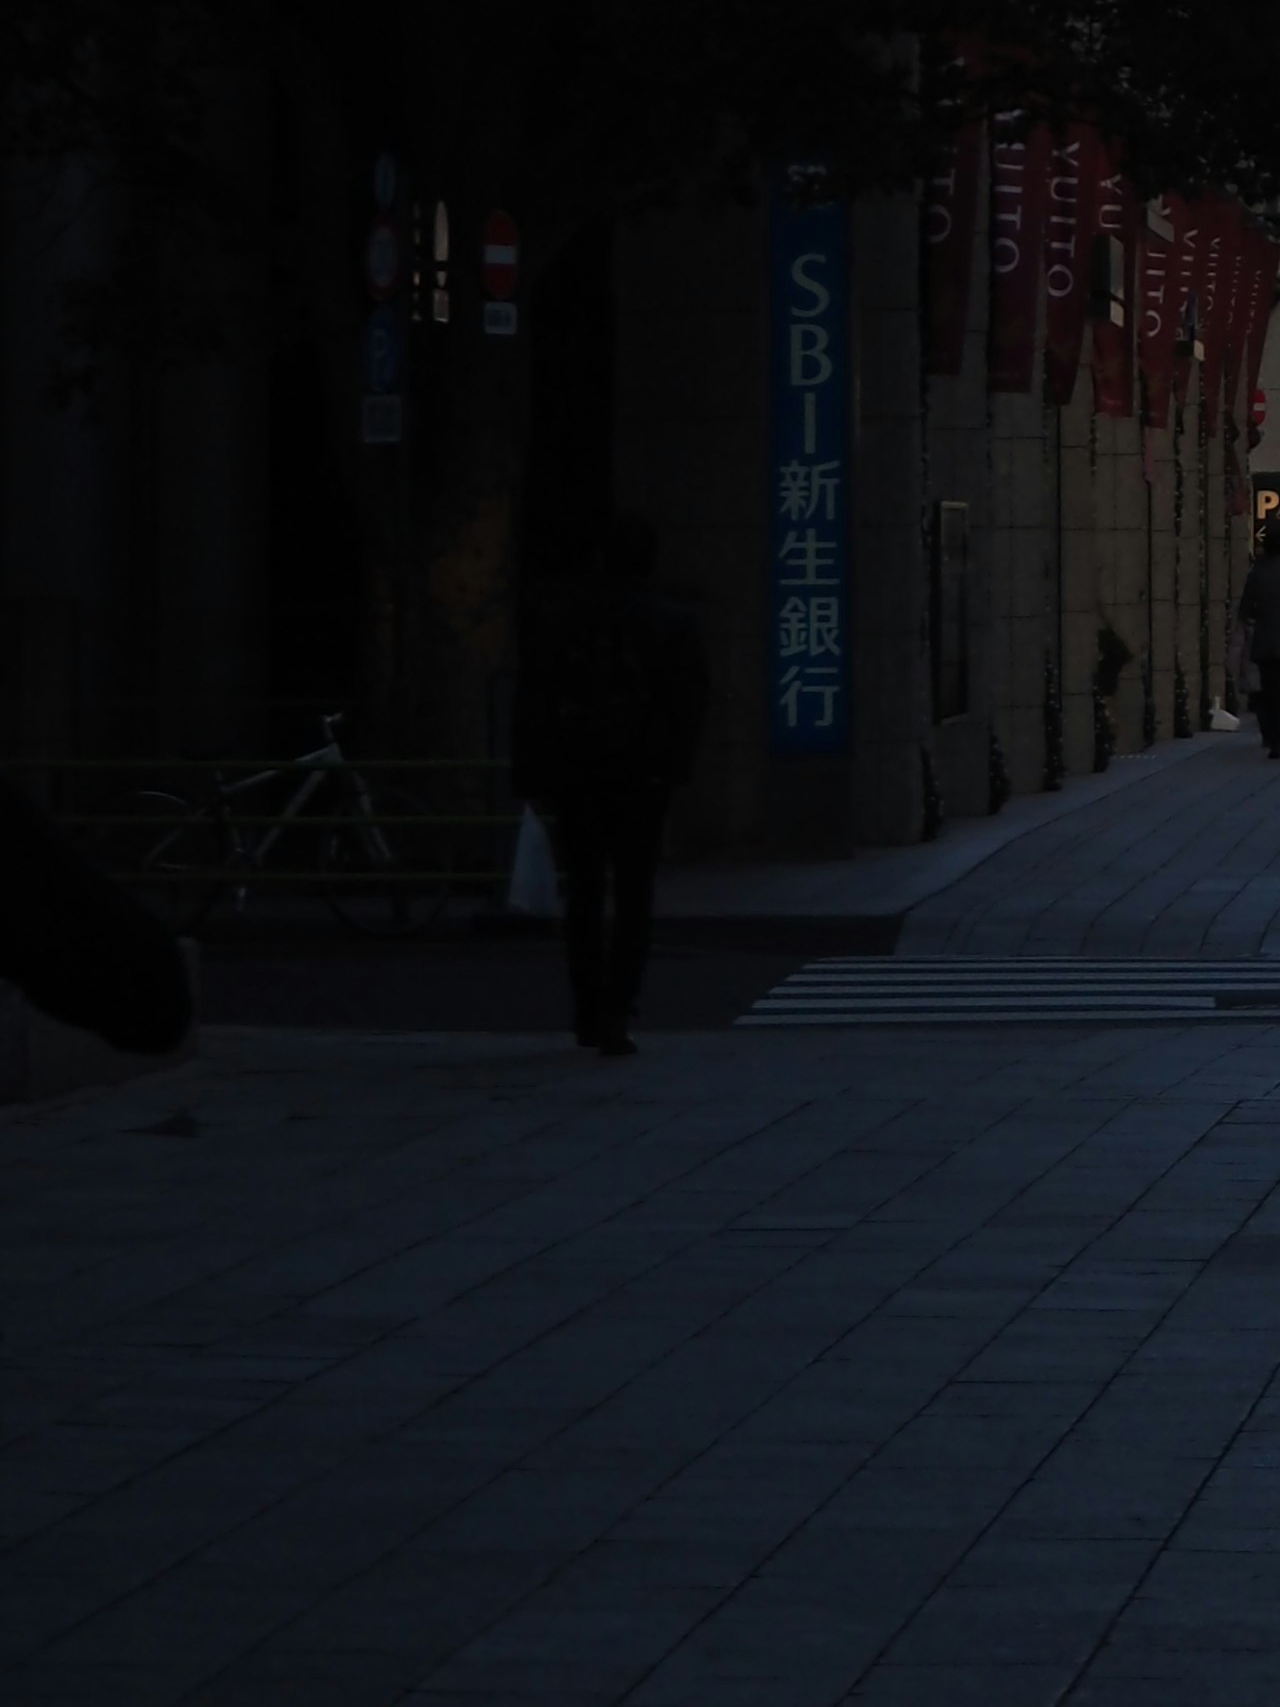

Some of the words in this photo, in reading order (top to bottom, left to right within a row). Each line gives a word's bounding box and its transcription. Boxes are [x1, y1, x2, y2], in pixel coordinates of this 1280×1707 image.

[1048, 141, 1080, 298] YUITO
[778, 253, 841, 727] SBI新生銀行
[1257, 489, 1280, 520] P
